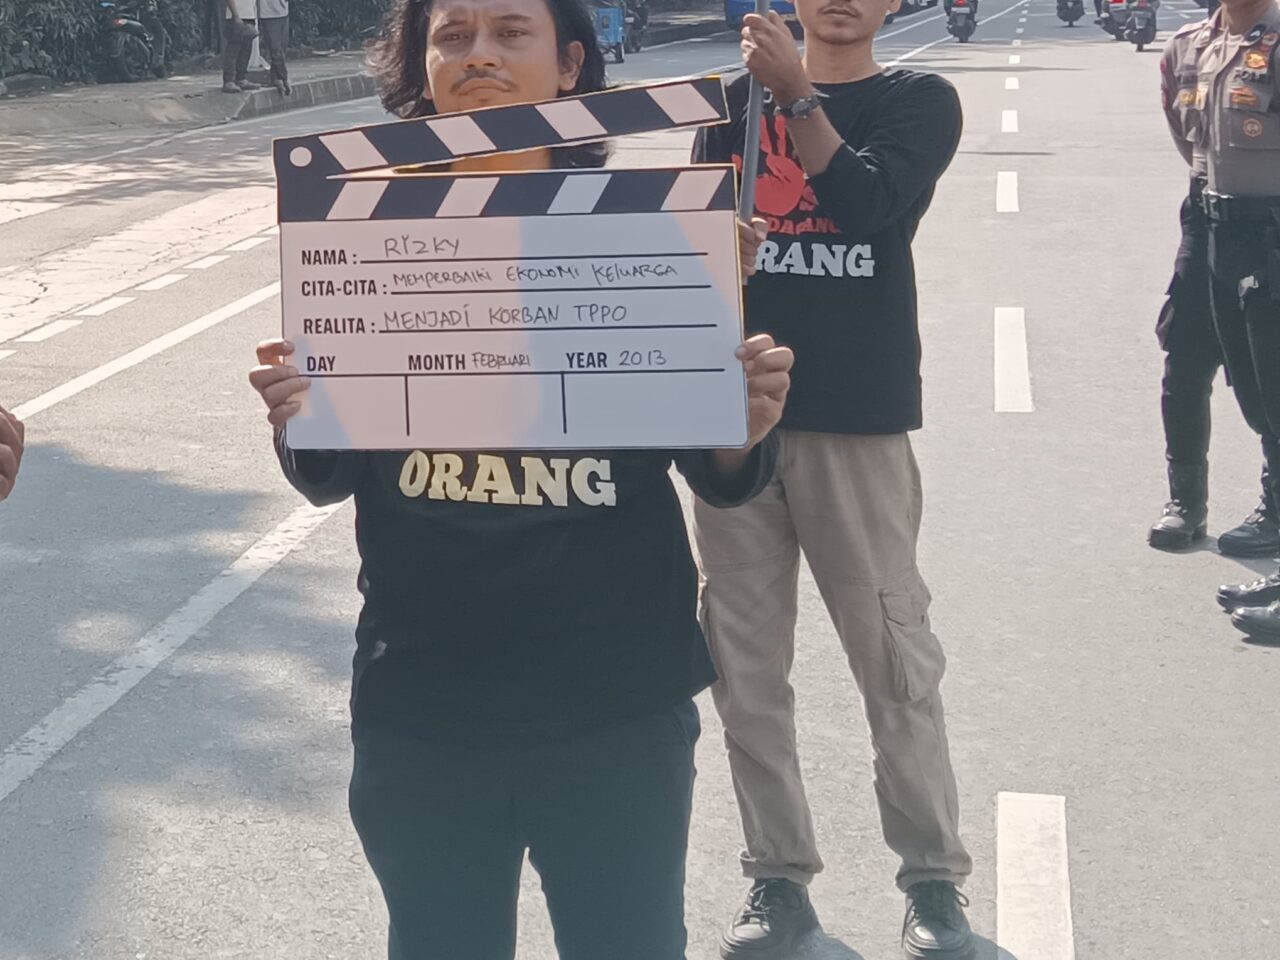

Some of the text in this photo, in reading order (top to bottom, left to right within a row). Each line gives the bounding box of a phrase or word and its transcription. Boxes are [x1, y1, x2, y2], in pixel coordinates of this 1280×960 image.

[301, 249, 348, 266] NAMA
[755, 240, 875, 278] RANG
[301, 279, 378, 297] CITA-CITA
[488, 304, 560, 326] KORBAN
[573, 303, 628, 324] TPPO
[303, 317, 366, 335] REALITA
[306, 355, 336, 372] DAY
[408, 354, 466, 371] MONTH
[565, 351, 608, 368] YEAR
[618, 349, 667, 367] 2013
[398, 448, 617, 509] ORANG
